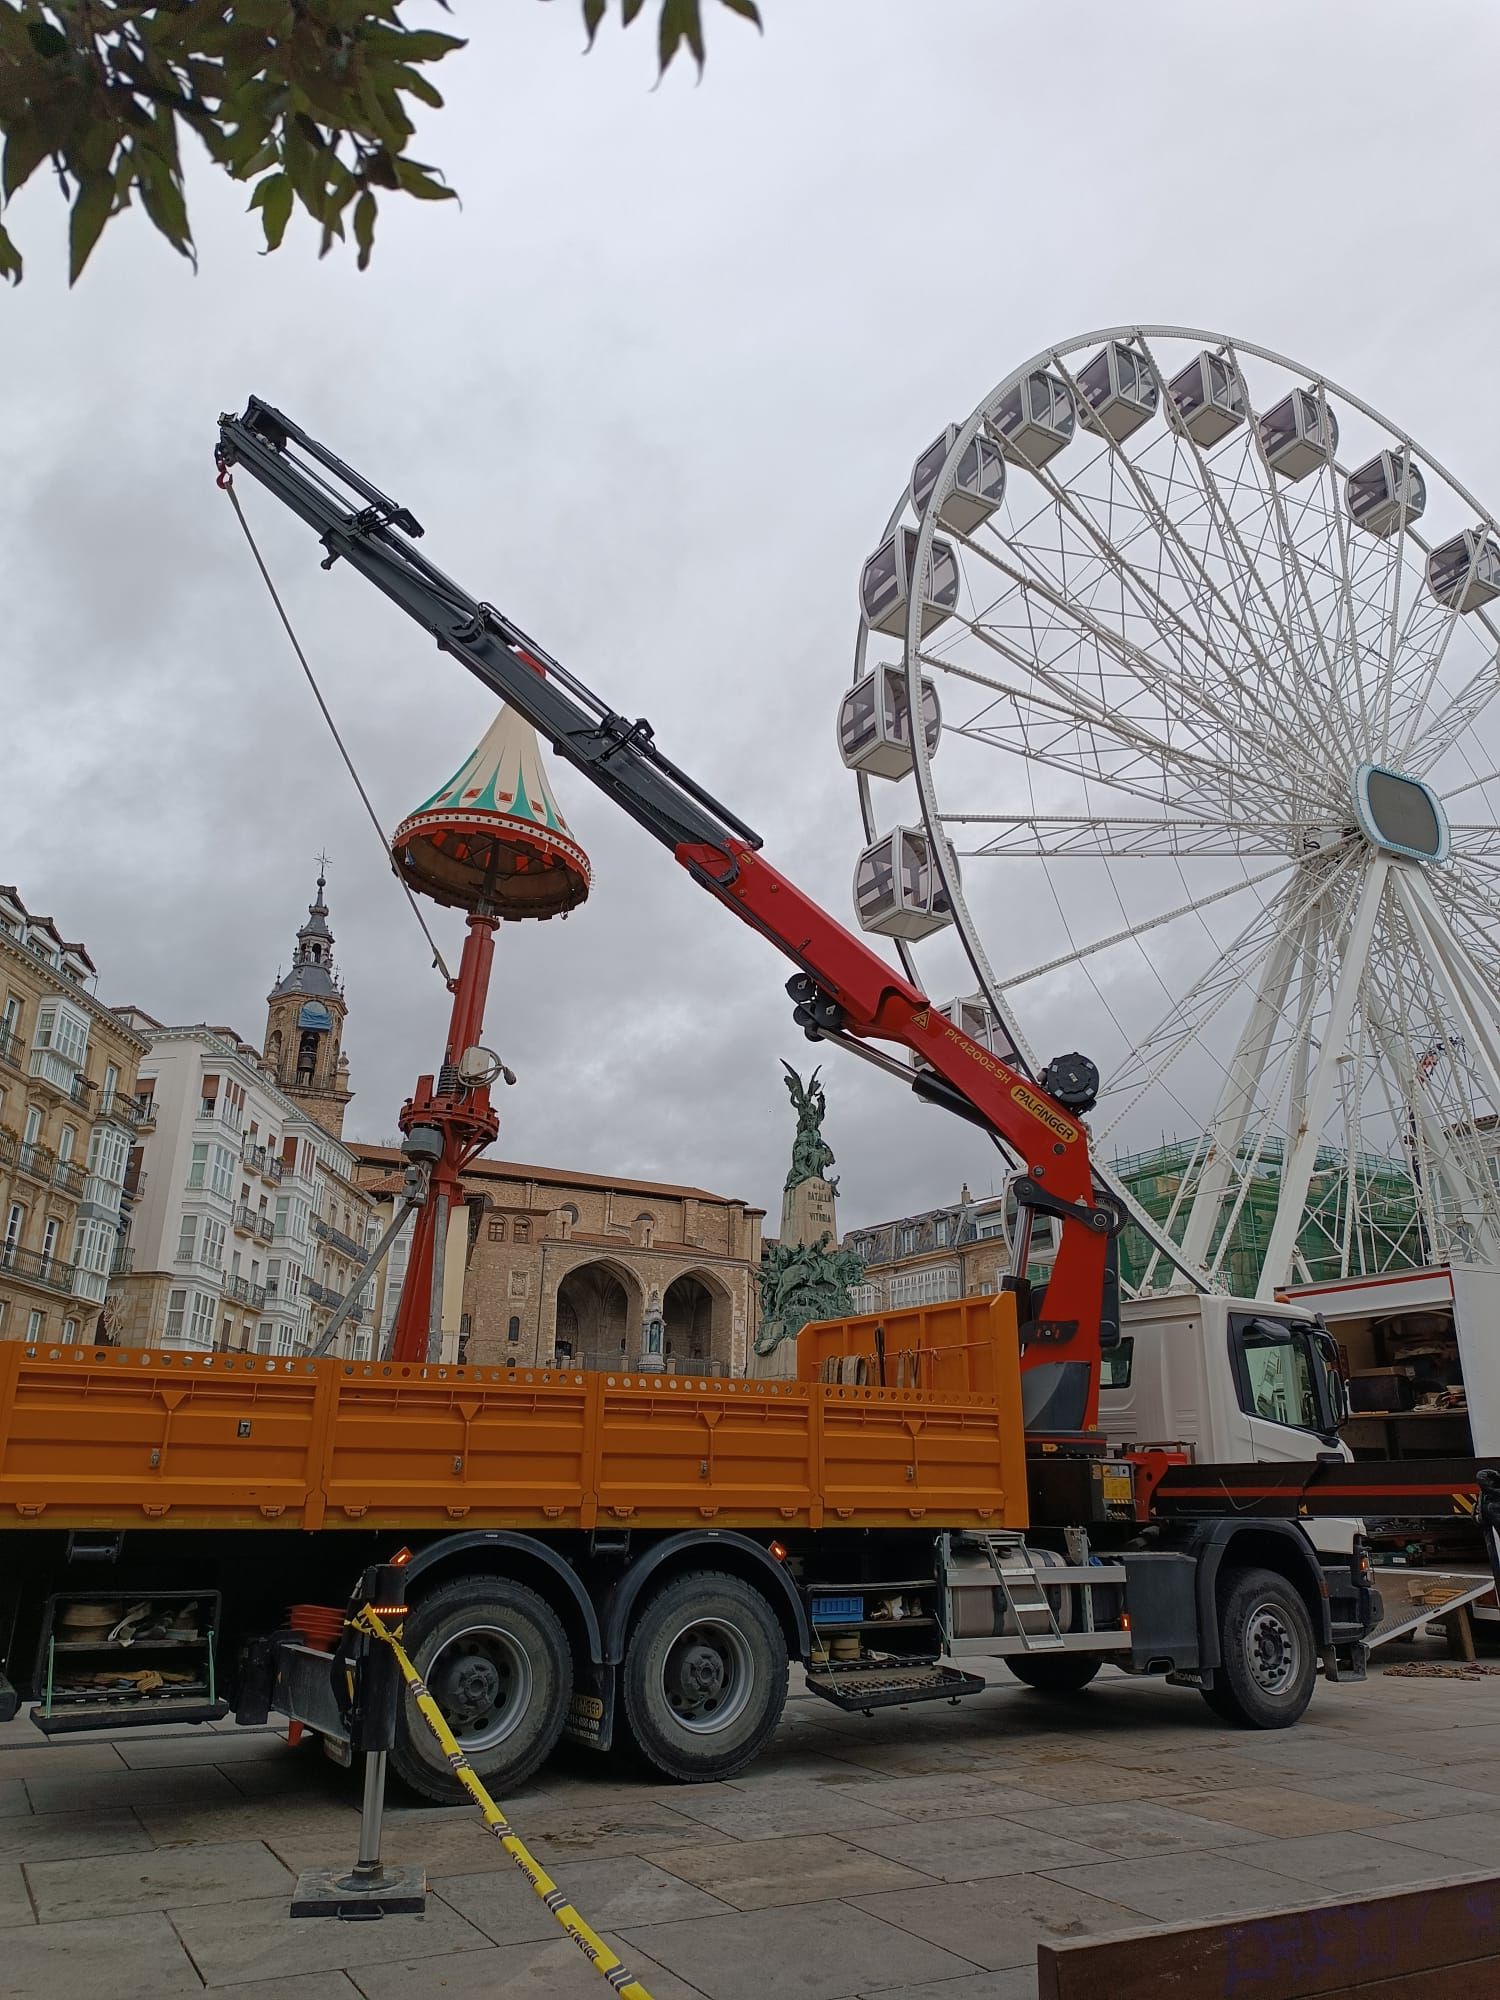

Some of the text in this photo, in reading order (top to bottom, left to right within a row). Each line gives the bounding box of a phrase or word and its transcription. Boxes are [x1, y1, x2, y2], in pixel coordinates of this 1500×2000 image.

[944, 1028, 961, 1045] PK
[1013, 1088, 1074, 1140] PALFINGER
[808, 1212, 832, 1223] VITORIA
